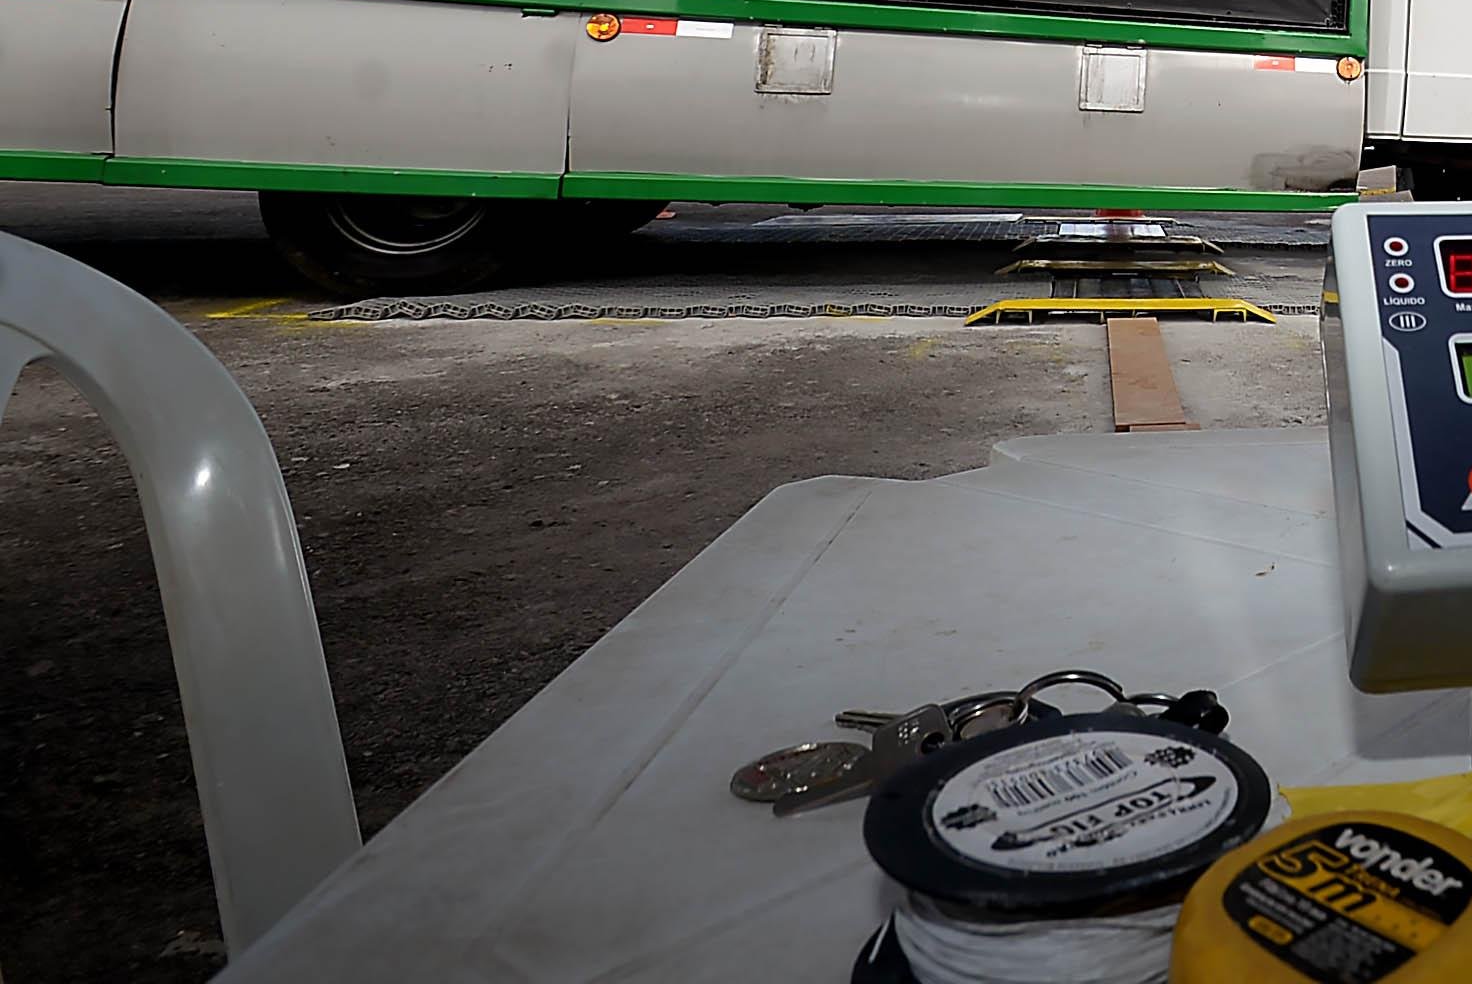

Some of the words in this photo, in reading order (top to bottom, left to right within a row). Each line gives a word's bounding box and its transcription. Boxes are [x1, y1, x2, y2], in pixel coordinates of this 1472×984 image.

[1385, 259, 1413, 267] ZERO
[1383, 297, 1426, 306] LÍQUIDO
[1115, 790, 1173, 817] TOP
[1335, 827, 1464, 897] vonder
